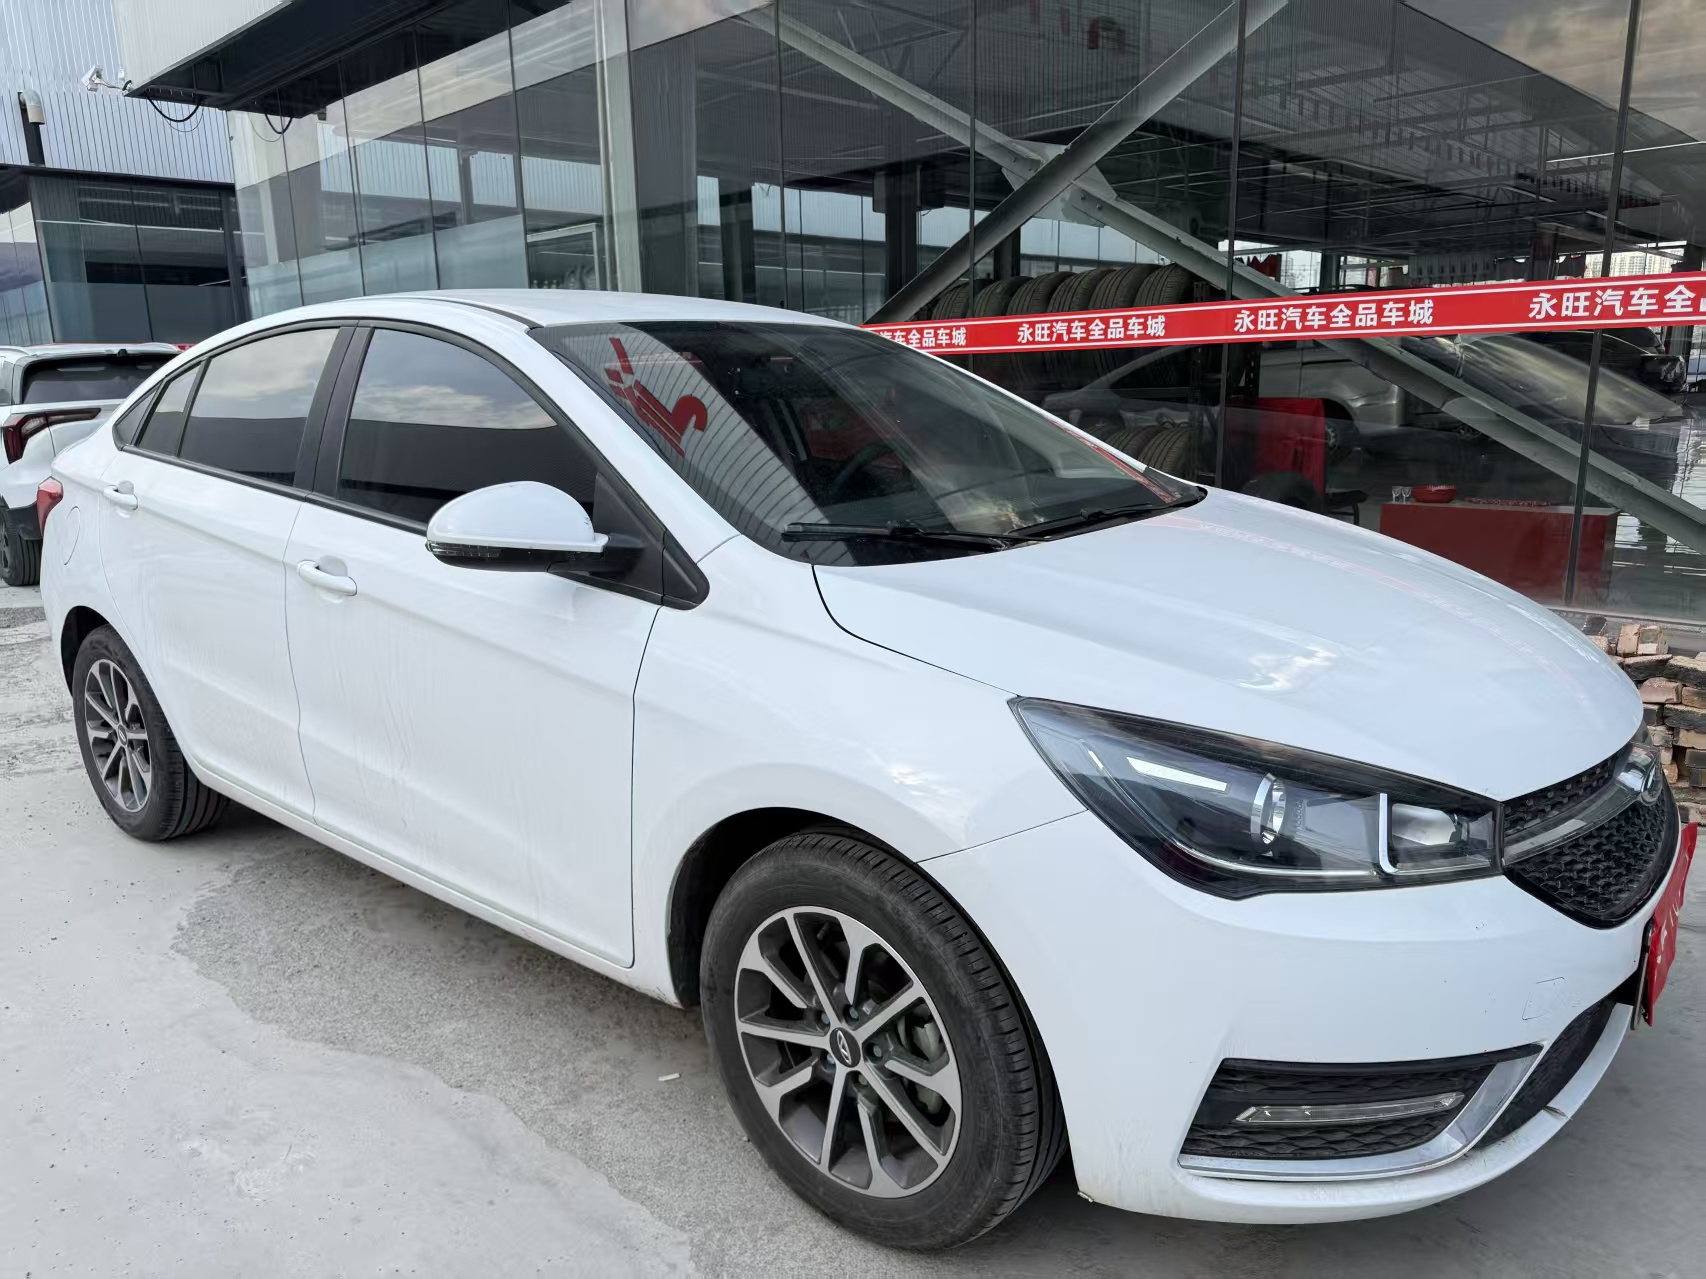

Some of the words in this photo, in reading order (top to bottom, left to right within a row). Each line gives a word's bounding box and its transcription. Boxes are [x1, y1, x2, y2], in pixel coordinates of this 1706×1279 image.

[1234, 300, 1434, 333] 永旺汽车全品车城
[1528, 284, 1706, 319] 永旺汽车全
[1017, 315, 1166, 344] 永旺汽车全品车城
